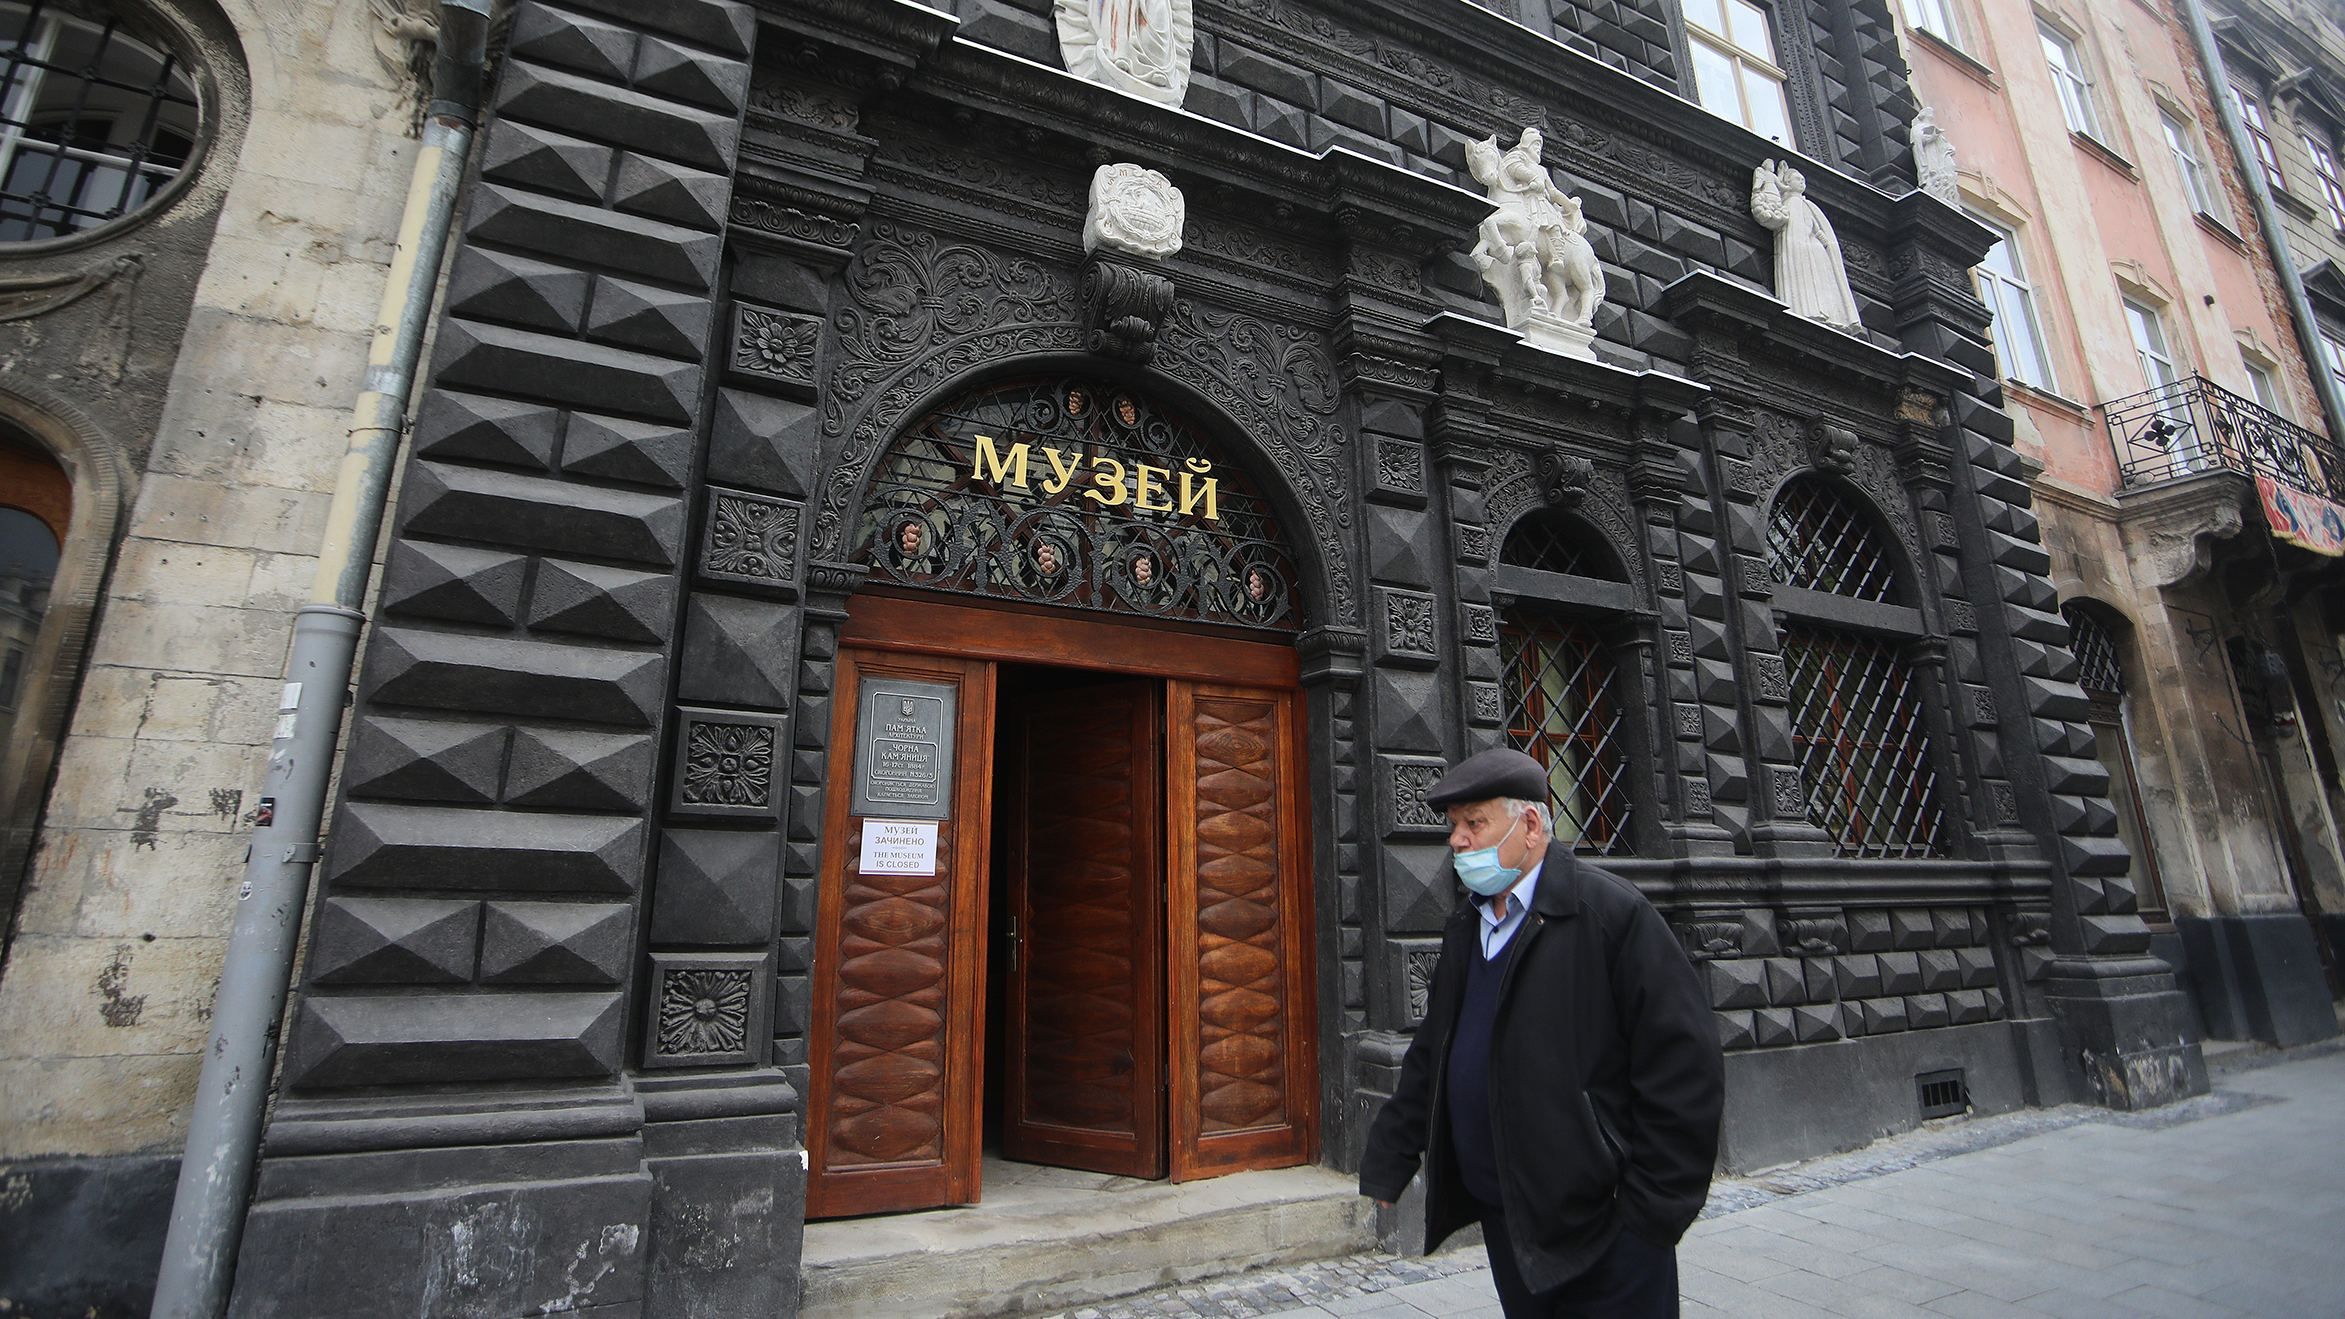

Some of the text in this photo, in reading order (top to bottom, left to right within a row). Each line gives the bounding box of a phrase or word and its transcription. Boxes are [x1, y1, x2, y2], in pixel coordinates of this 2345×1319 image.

[970, 434, 1220, 521] МУЗЕЙ
[884, 825, 918, 836] МУЗЕЙ
[874, 836, 925, 846] ЗАЧИНЕНО
[873, 851, 924, 860] THE MUSEUM
[876, 860, 920, 869] IS CLOSED
